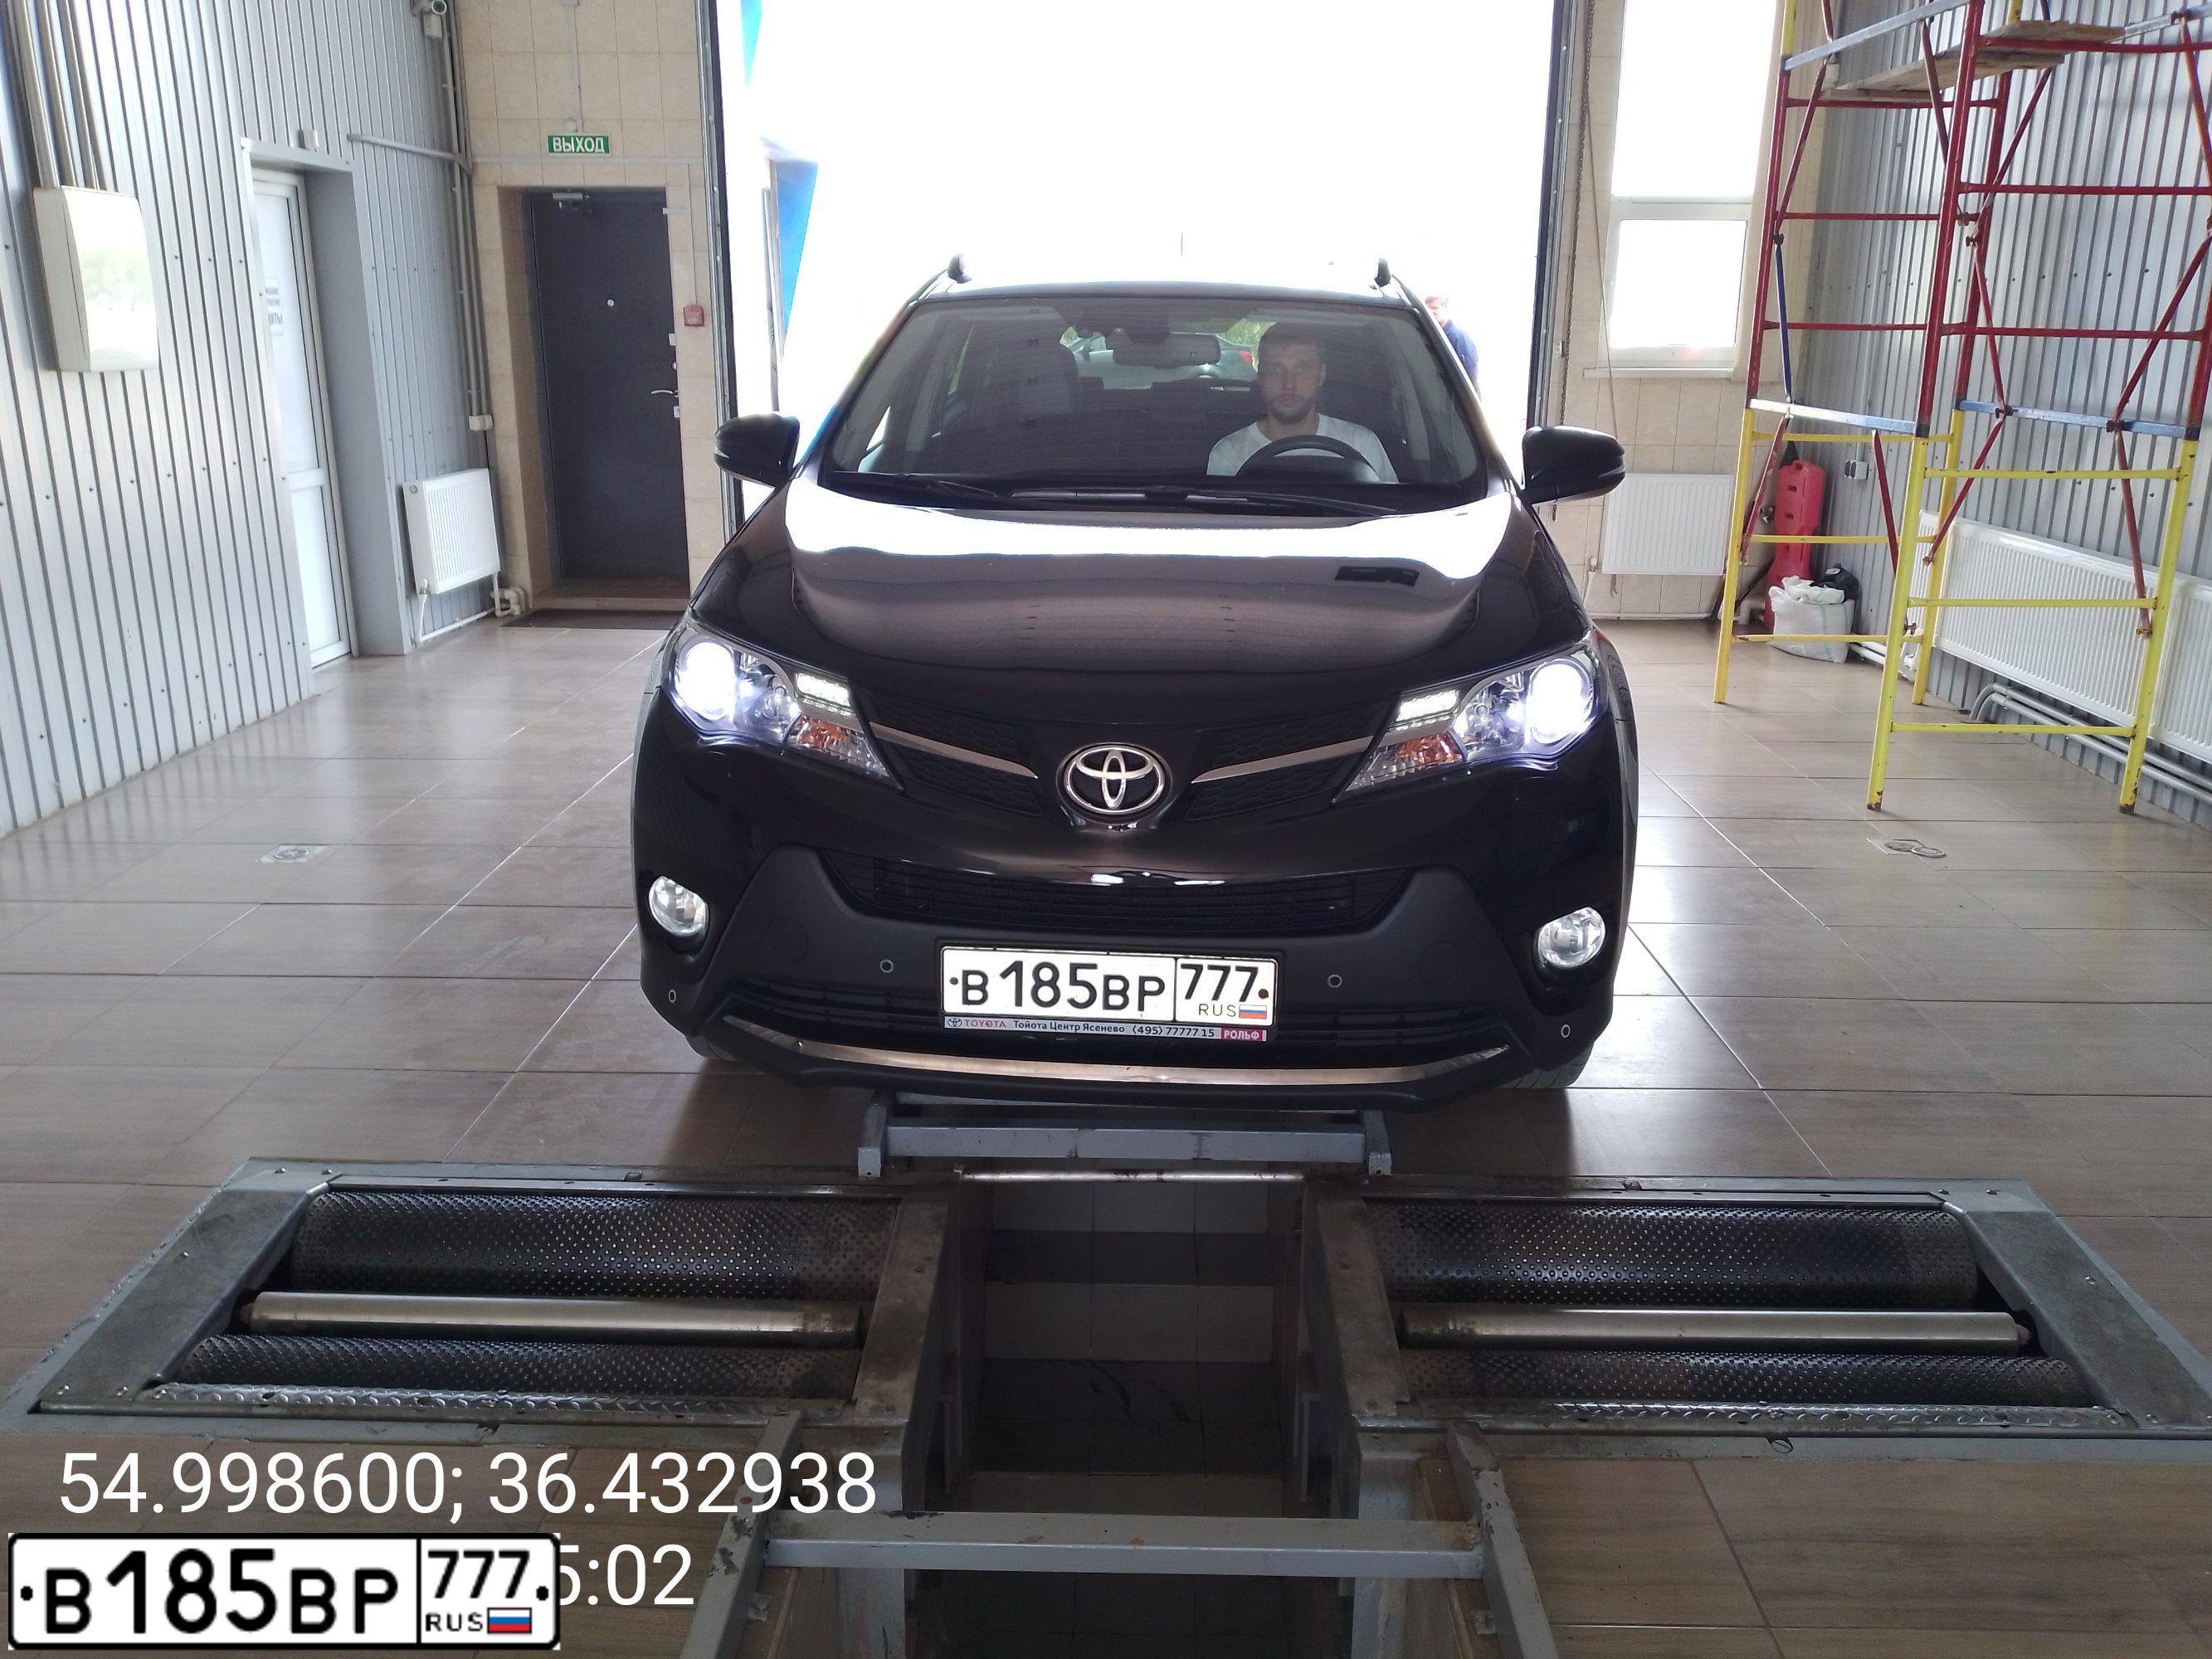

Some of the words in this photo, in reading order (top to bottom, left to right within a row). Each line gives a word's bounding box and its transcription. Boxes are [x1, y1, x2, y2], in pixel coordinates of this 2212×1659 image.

[553, 136, 605, 153] ВЫХОД
[1180, 963, 1259, 1002] 777
[1198, 1003, 1236, 1017] RUS
[964, 1019, 1006, 1029] TOYOTA
[1013, 1019, 1047, 1030] Тойота
[1050, 1021, 1080, 1034] Центр
[1083, 1022, 1125, 1033] Ясенево
[1132, 1024, 1162, 1036] (495)
[1224, 1029, 1260, 1040] РОЛЬФ
